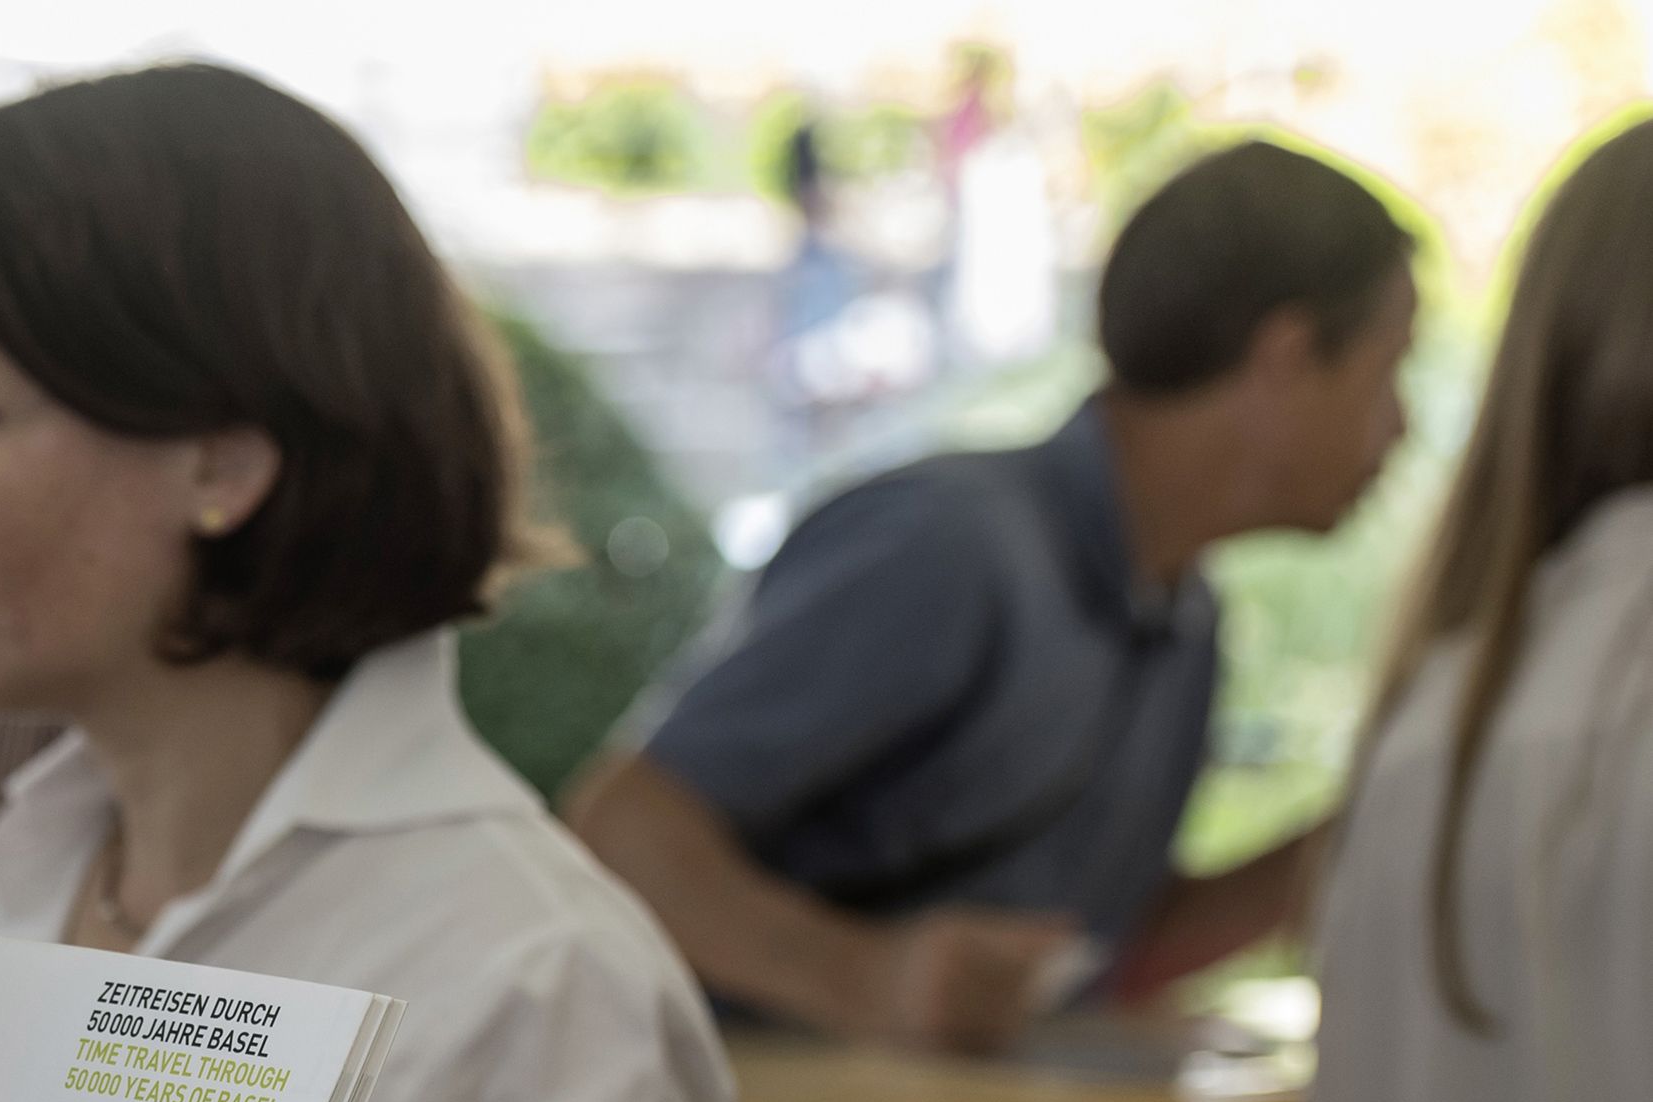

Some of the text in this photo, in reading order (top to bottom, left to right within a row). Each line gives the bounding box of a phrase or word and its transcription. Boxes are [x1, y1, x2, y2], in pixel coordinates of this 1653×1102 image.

[97, 981, 281, 1027] ZEITREISEN DURCH
[142, 1019, 207, 1047] JAHRE
[207, 1027, 269, 1057] BASEL
[76, 1038, 290, 1092] TIME TRAVEL THROUGH
